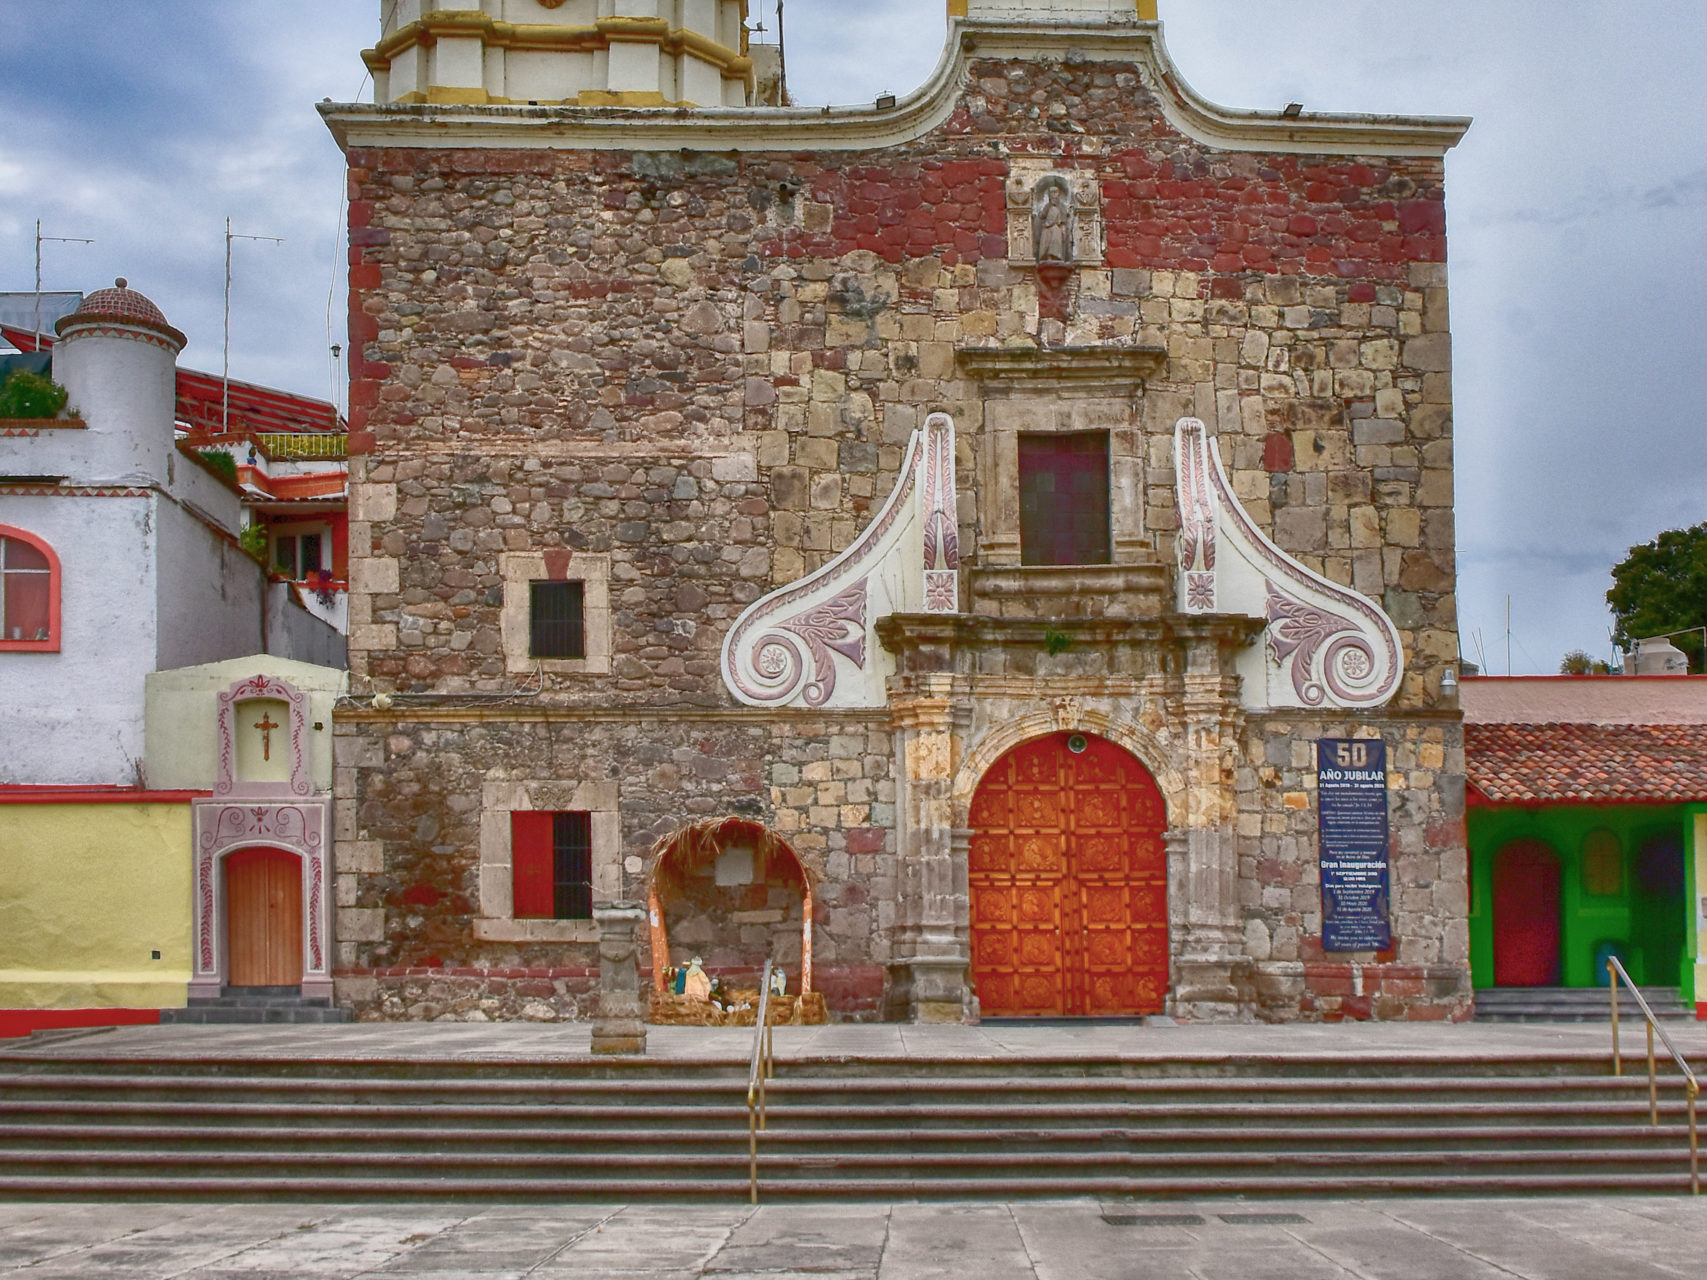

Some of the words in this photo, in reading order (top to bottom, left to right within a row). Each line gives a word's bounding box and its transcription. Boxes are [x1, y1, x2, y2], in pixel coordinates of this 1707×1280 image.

[1336, 742, 1367, 767] 50
[1319, 768, 1342, 780] AÑO
[1343, 770, 1385, 781] JUBILAR
[1320, 860, 1338, 869] Gran
[1339, 860, 1387, 870] Inauguración
